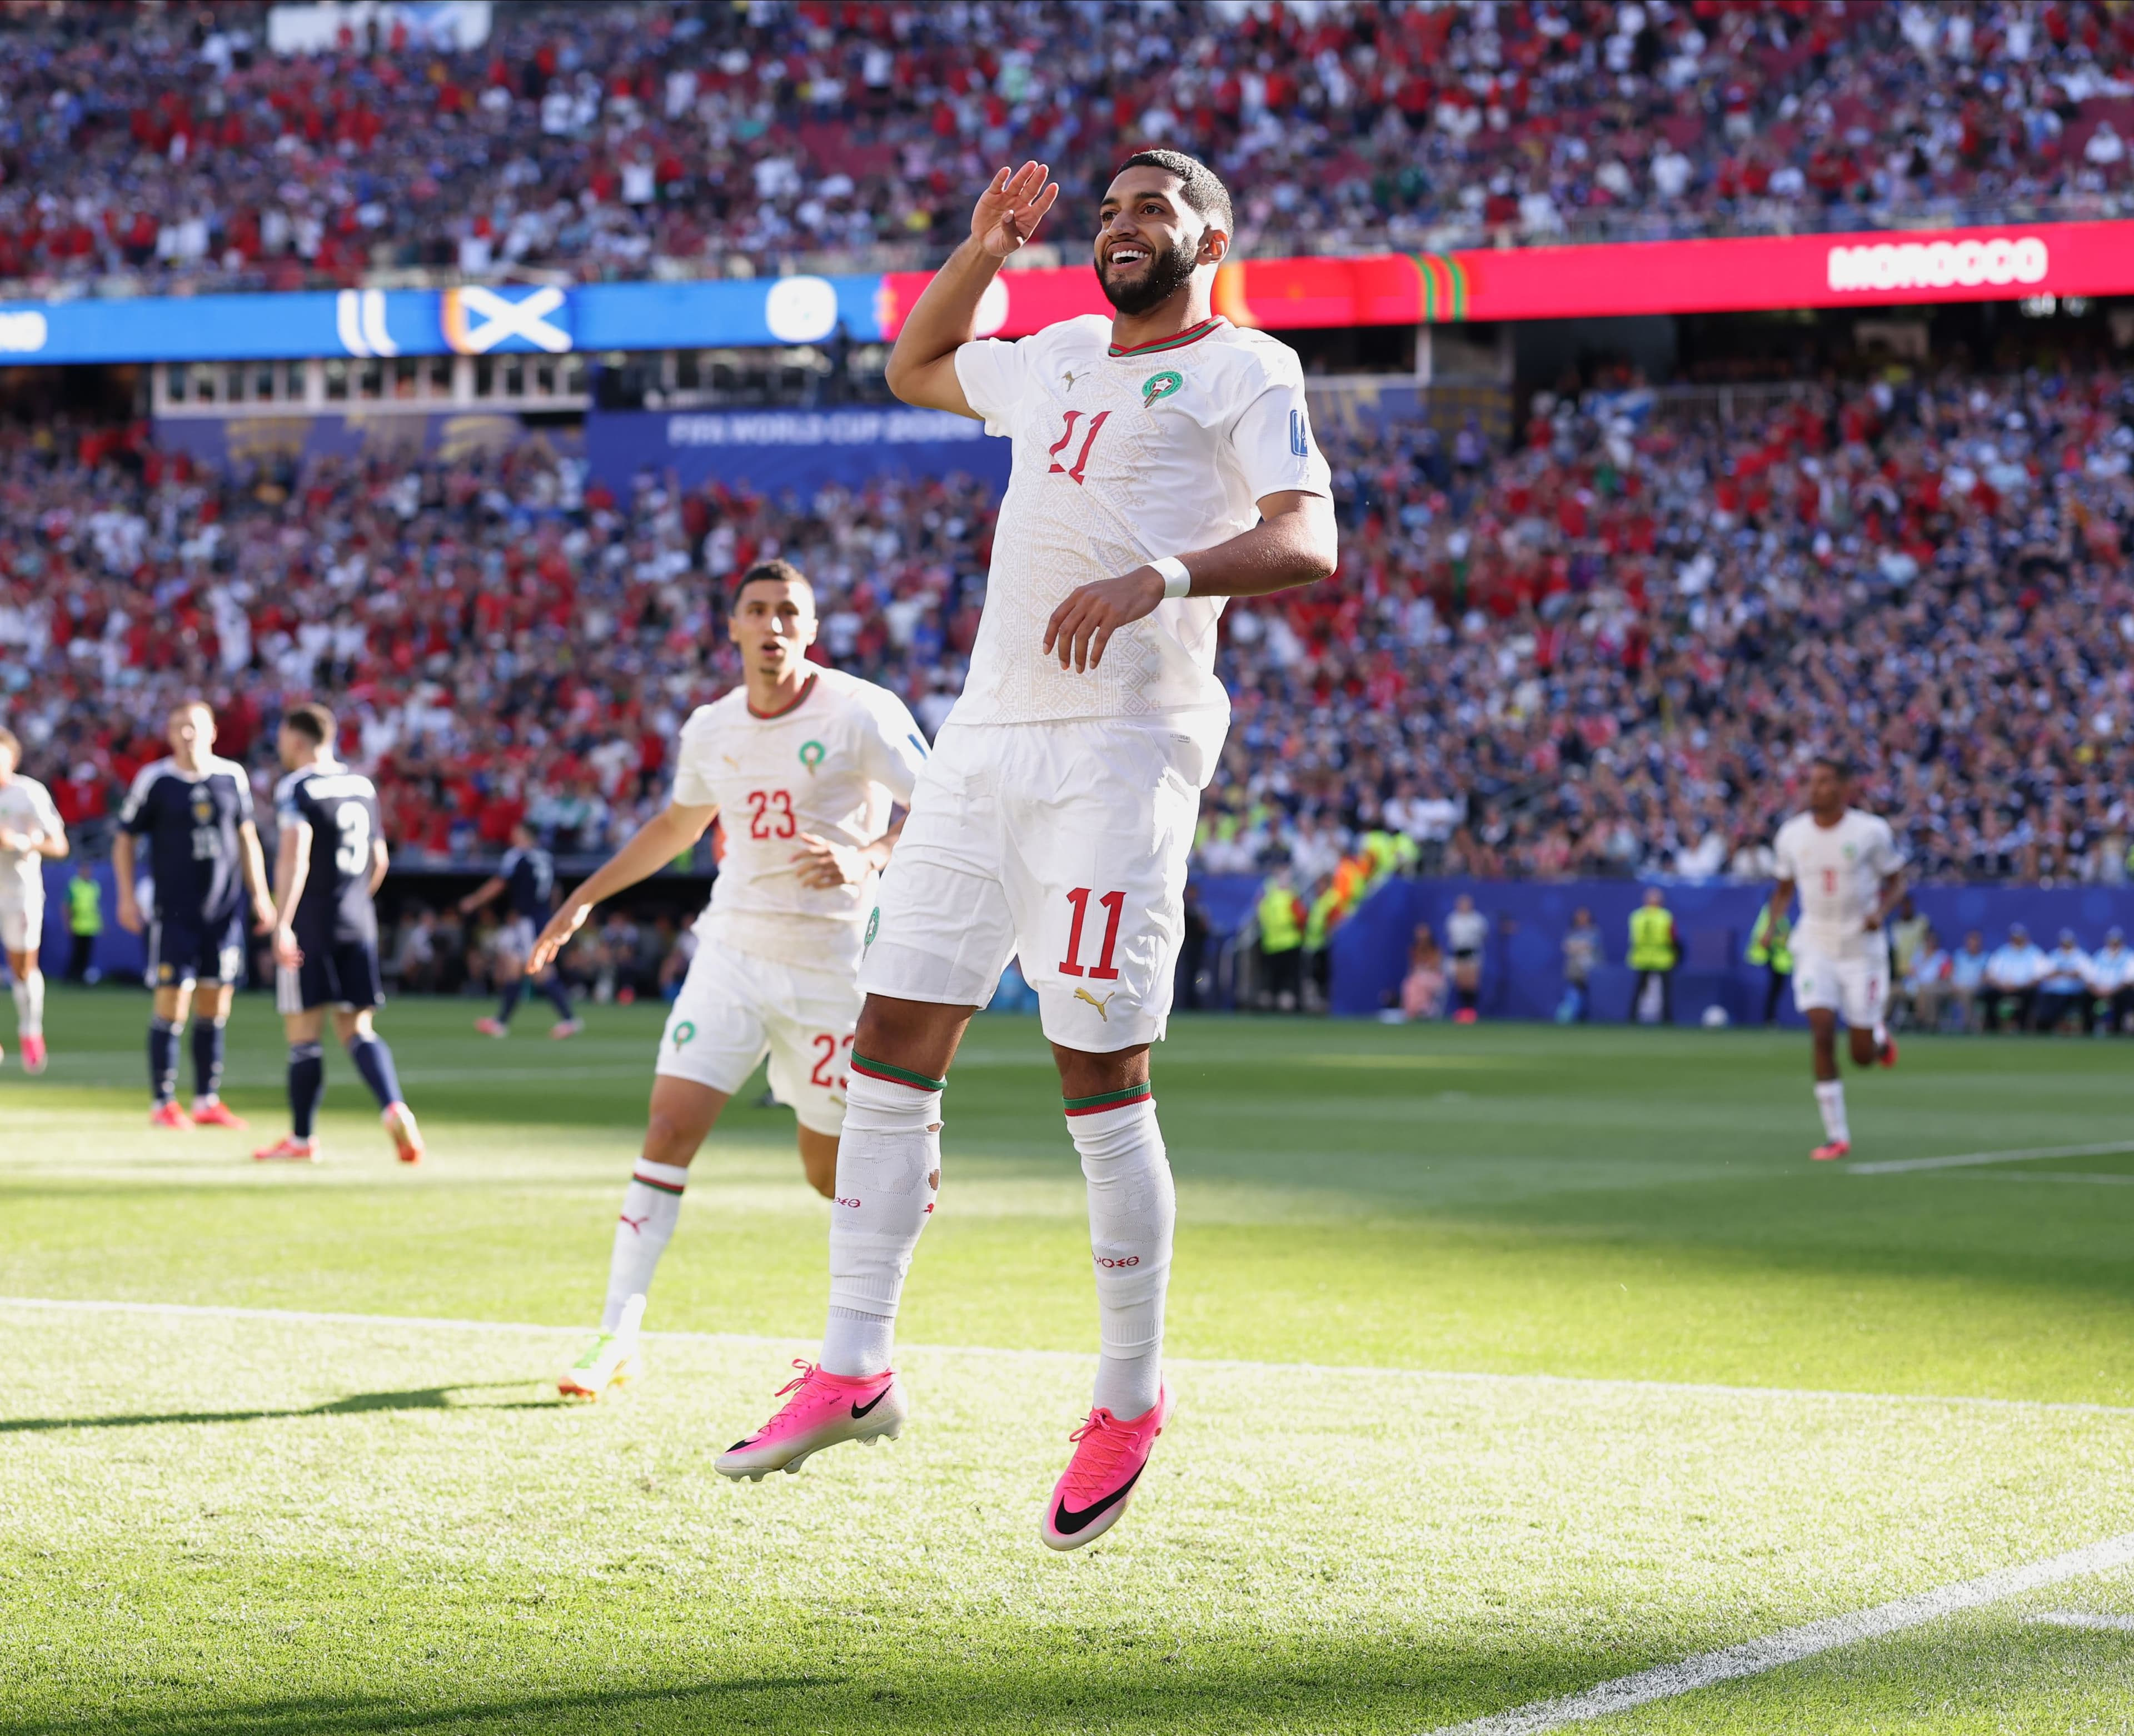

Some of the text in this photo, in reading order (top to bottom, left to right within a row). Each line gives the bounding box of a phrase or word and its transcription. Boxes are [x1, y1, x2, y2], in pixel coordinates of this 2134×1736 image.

[1827, 237, 2048, 291] MOROCCO
[667, 415, 724, 445] FIFA
[731, 413, 823, 444] WORLD
[827, 412, 880, 443] CUP
[336, 801, 370, 875] 3
[747, 789, 796, 840] 23
[1058, 887, 1126, 980] 11
